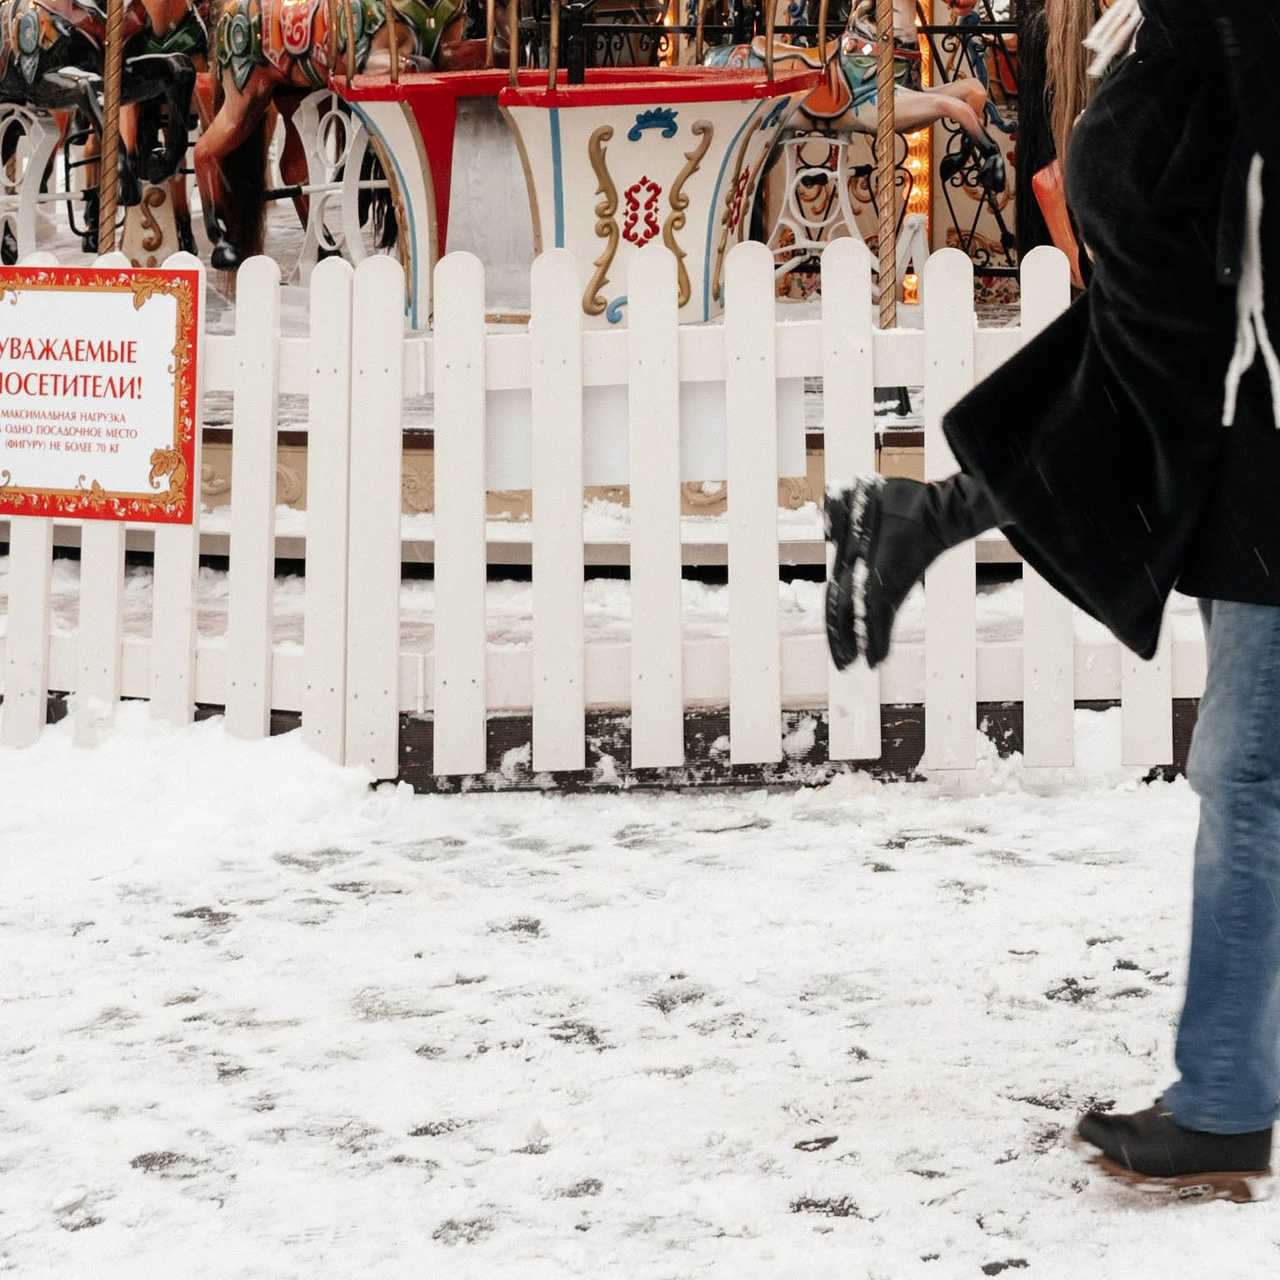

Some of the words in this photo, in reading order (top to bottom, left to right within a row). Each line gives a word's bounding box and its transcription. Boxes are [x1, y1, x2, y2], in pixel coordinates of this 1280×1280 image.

[0, 372, 142, 399] ОСЕТИТЕЛИ!
[1, 409, 76, 421] МАКСИМАЛЬНАЯ
[80, 412, 126, 423] НАГРУЗКА
[5, 423, 33, 434] ОДНО
[36, 425, 102, 437] ПОСАДОЧНОЕ
[106, 429, 138, 439] МЕСТО
[5, 439, 46, 450] (ФИГУРУ)
[49, 441, 60, 451] НЕ
[65, 441, 93, 452] БОЛЕЕ
[96, 443, 106, 453] 70
[110, 444, 120, 453] КГ
